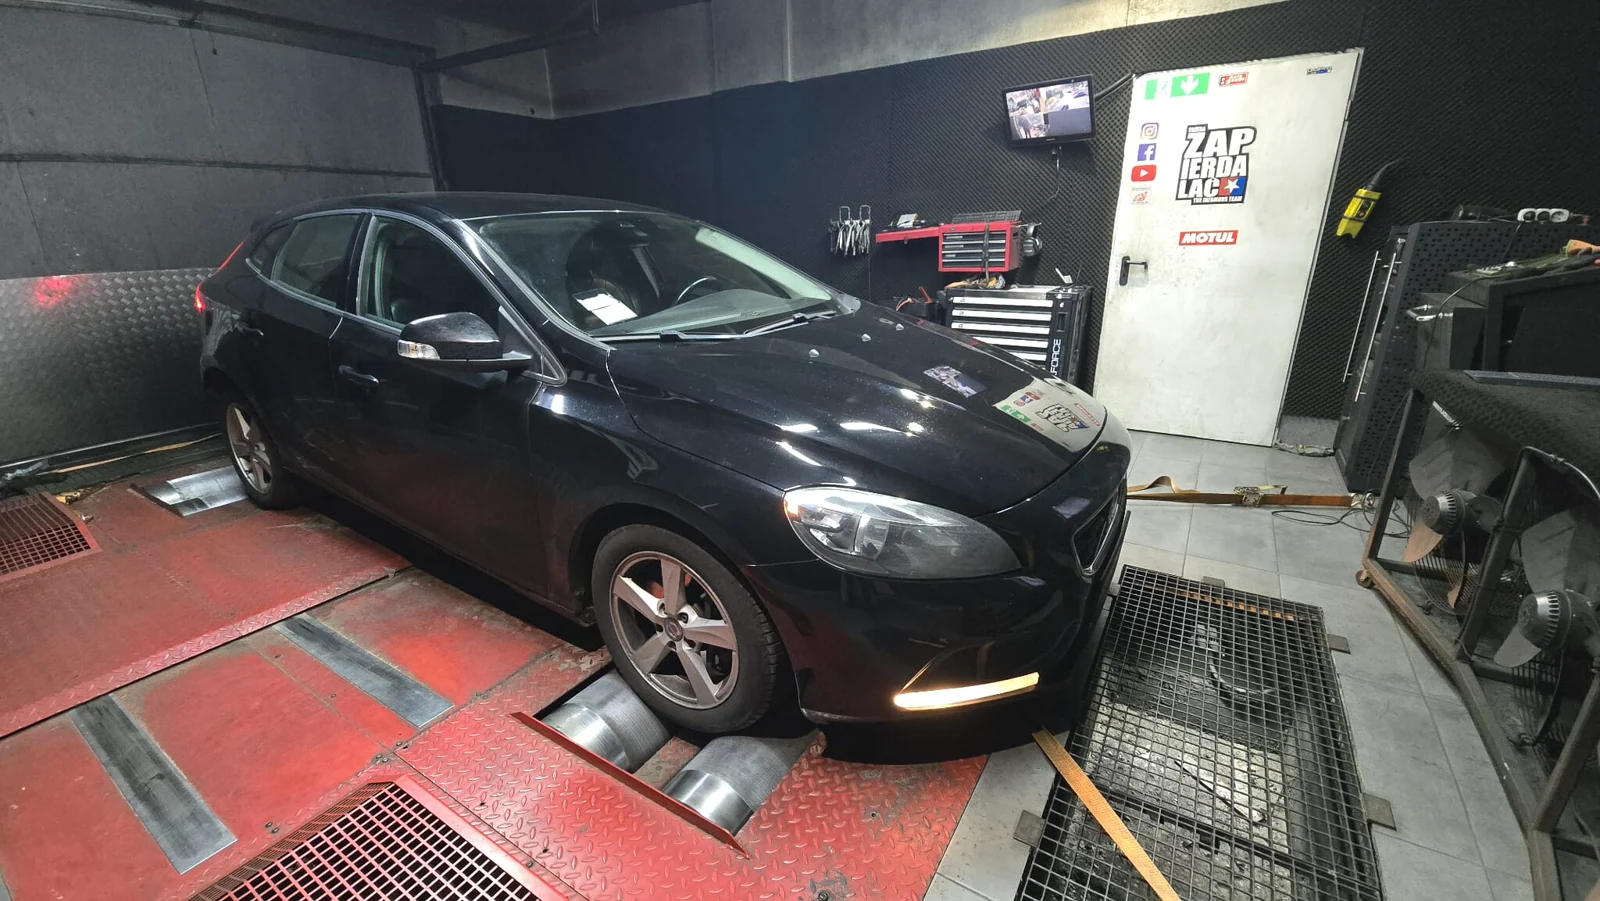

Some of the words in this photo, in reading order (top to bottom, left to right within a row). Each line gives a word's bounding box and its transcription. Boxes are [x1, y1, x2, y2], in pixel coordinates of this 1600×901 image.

[1182, 126, 1256, 158] ZAP
[1180, 154, 1247, 179] IERDA
[1181, 231, 1234, 244] MOTUL
